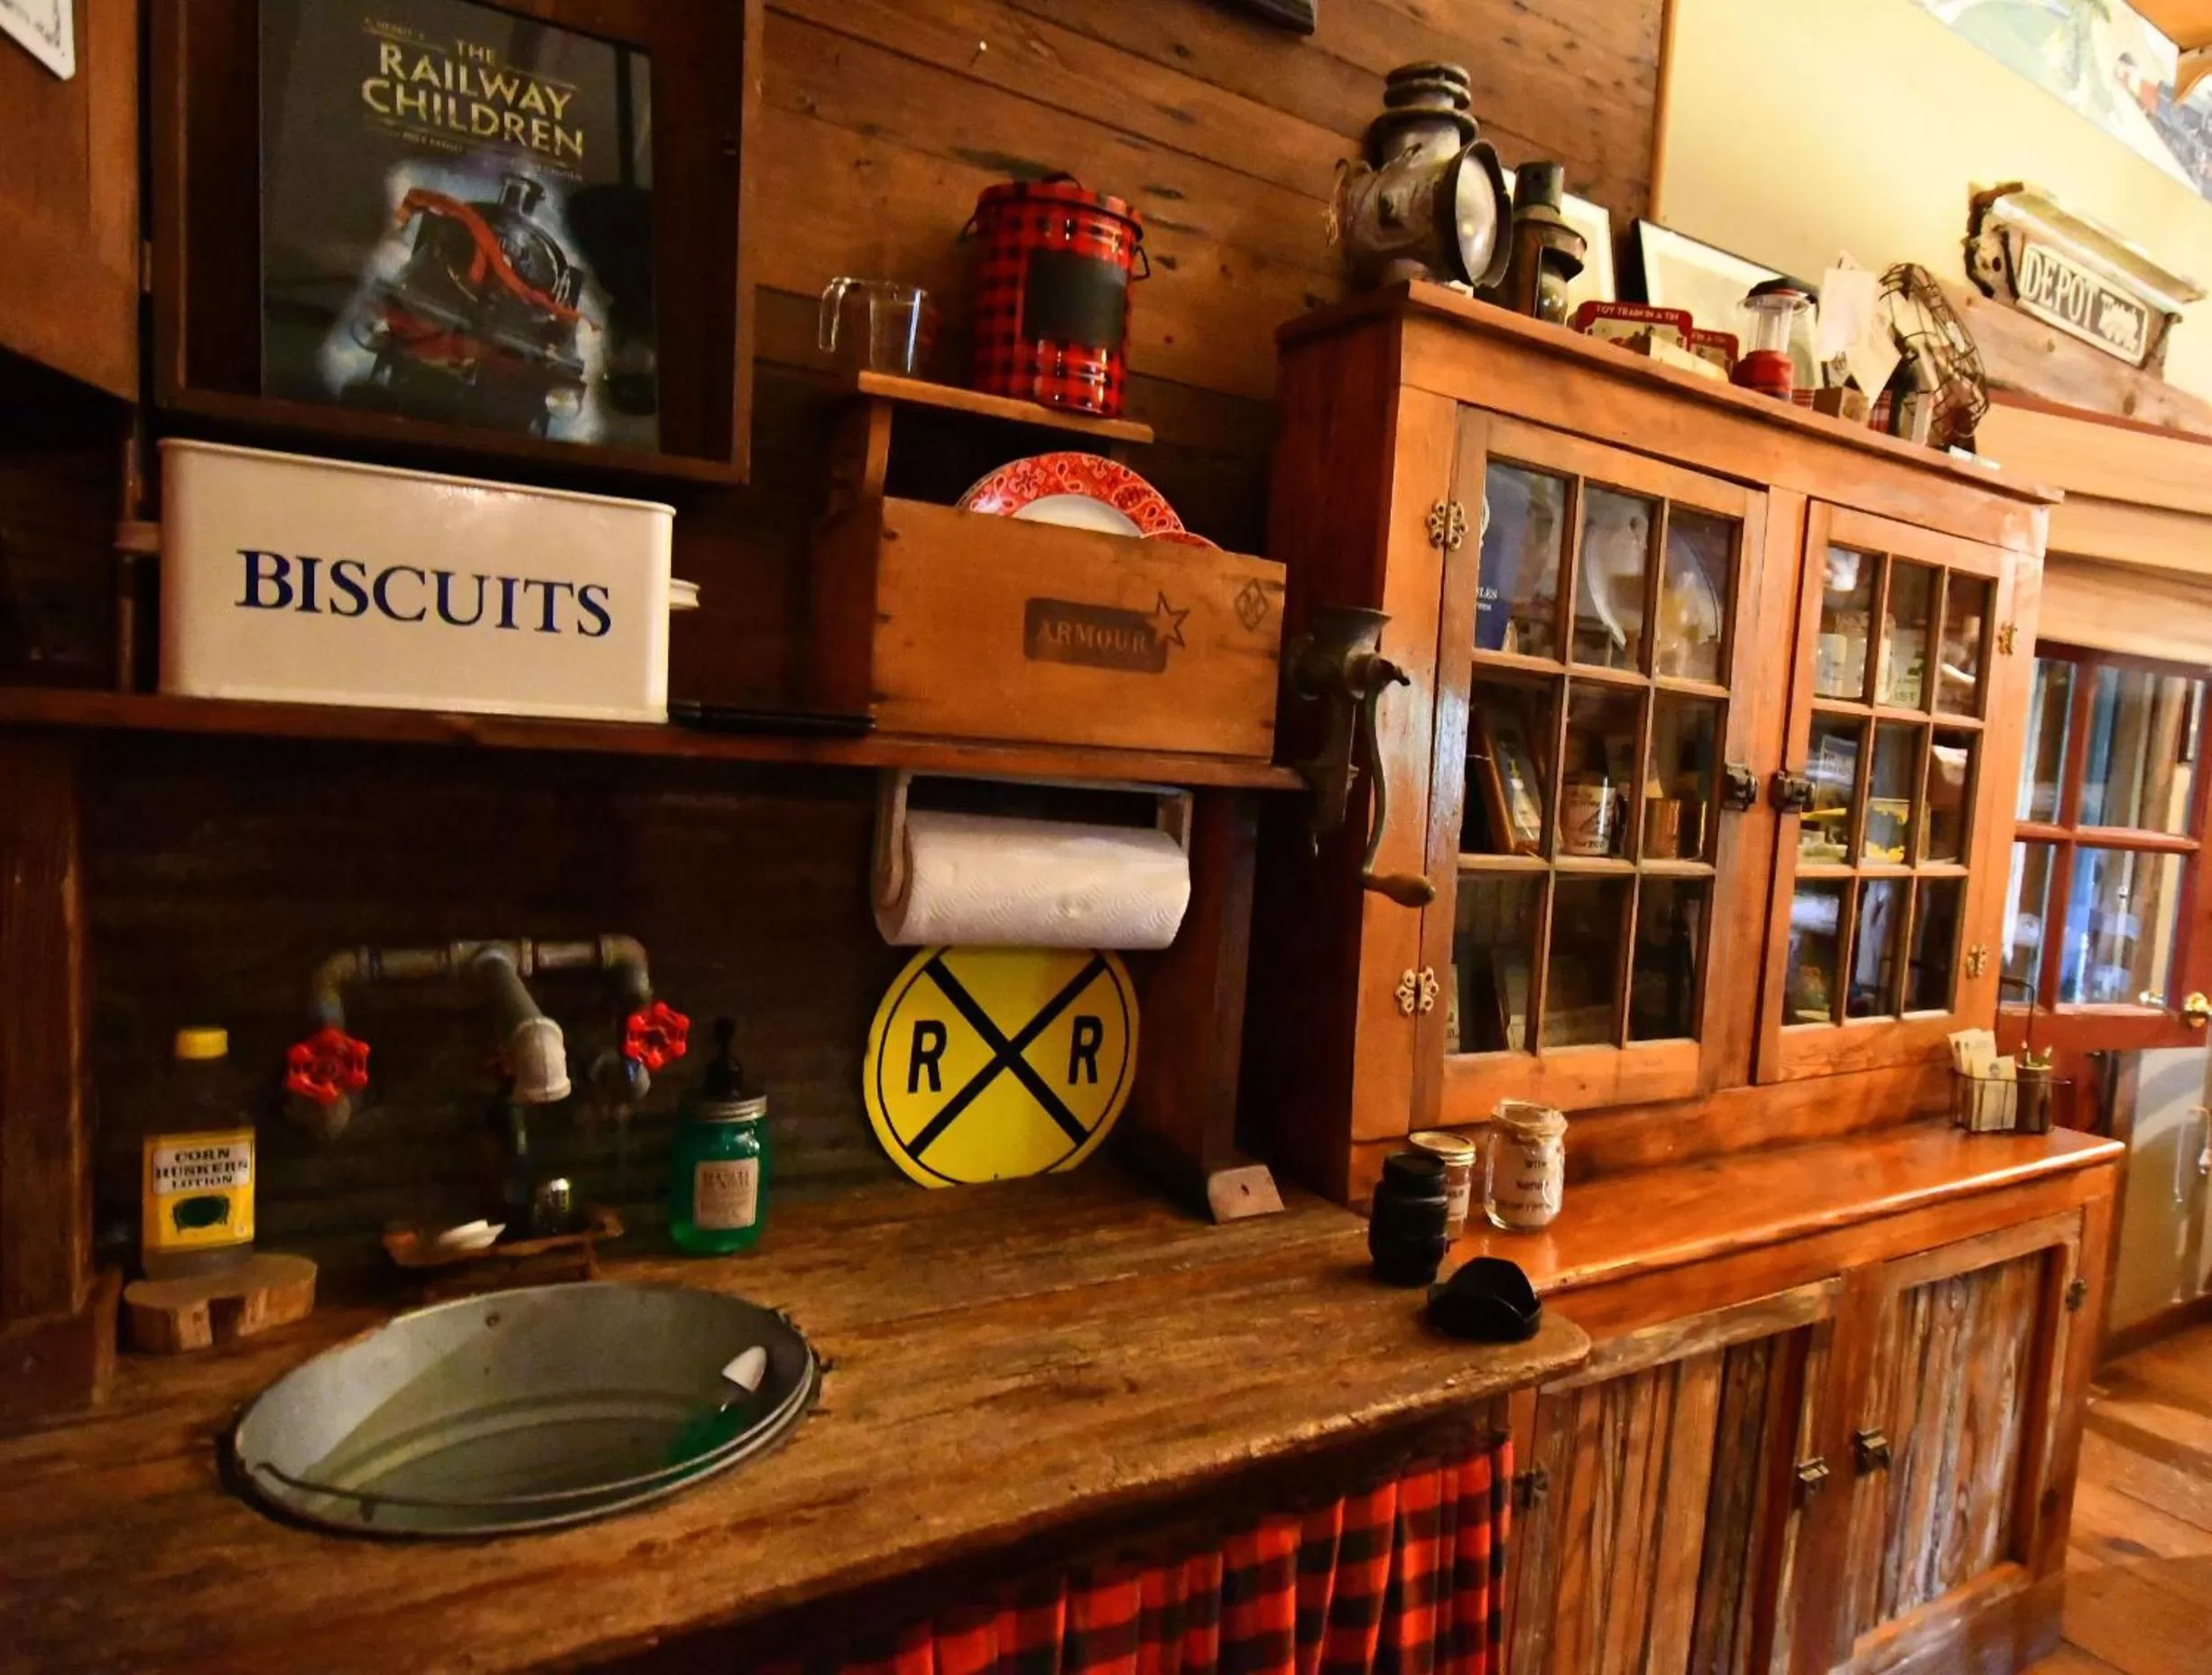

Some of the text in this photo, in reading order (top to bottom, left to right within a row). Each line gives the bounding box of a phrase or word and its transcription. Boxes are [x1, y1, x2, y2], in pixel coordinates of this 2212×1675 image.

[455, 40, 495, 65] THE
[380, 42, 572, 120] RAILWAY
[362, 78, 583, 159] CHILDREN
[1596, 304, 1680, 321] TOY TRAIN IN A TIN
[2025, 249, 2100, 332] DEPOT
[236, 549, 611, 637] BISCUITS
[1038, 618, 1148, 653] ARMOUR
[907, 1015, 1103, 1094] R R
[171, 1175, 232, 1189] LOTION
[175, 1147, 230, 1163] CORN
